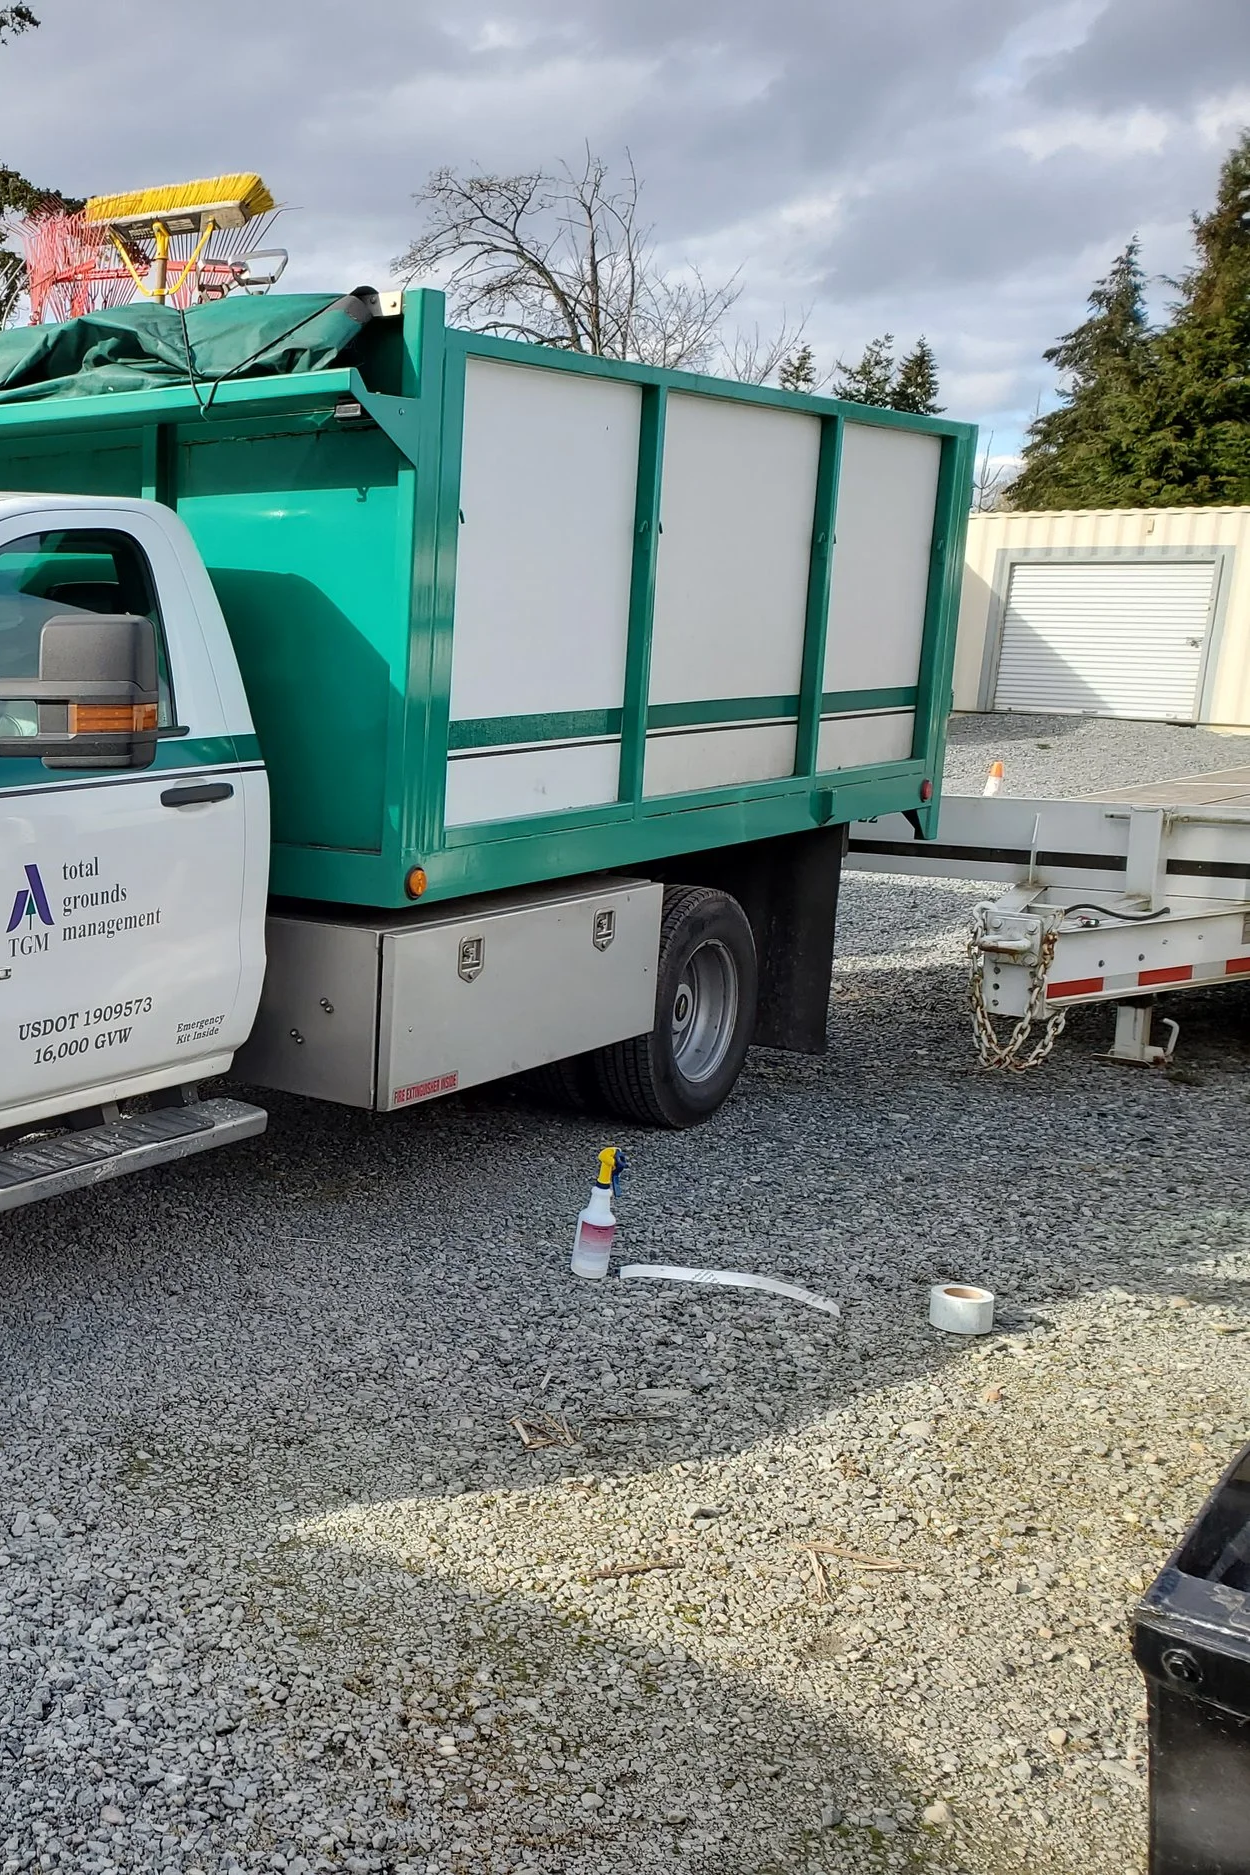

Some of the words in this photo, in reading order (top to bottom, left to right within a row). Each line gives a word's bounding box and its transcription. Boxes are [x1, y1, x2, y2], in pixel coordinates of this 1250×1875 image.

[62, 856, 100, 880] total
[62, 883, 128, 917] grounds
[62, 907, 162, 941] management
[8, 932, 51, 957] TGM
[18, 1012, 80, 1041] USDOT
[83, 996, 153, 1028] 1909573
[176, 1014, 225, 1033] Emergency
[33, 1037, 89, 1065] 16,000
[94, 1026, 133, 1050] GVW
[175, 1033, 191, 1045] Kit
[192, 1026, 220, 1041] Inside
[393, 1088, 406, 1104] FIRE
[406, 1078, 440, 1101] EXTINGUISHER
[440, 1073, 457, 1090] INSIDE
